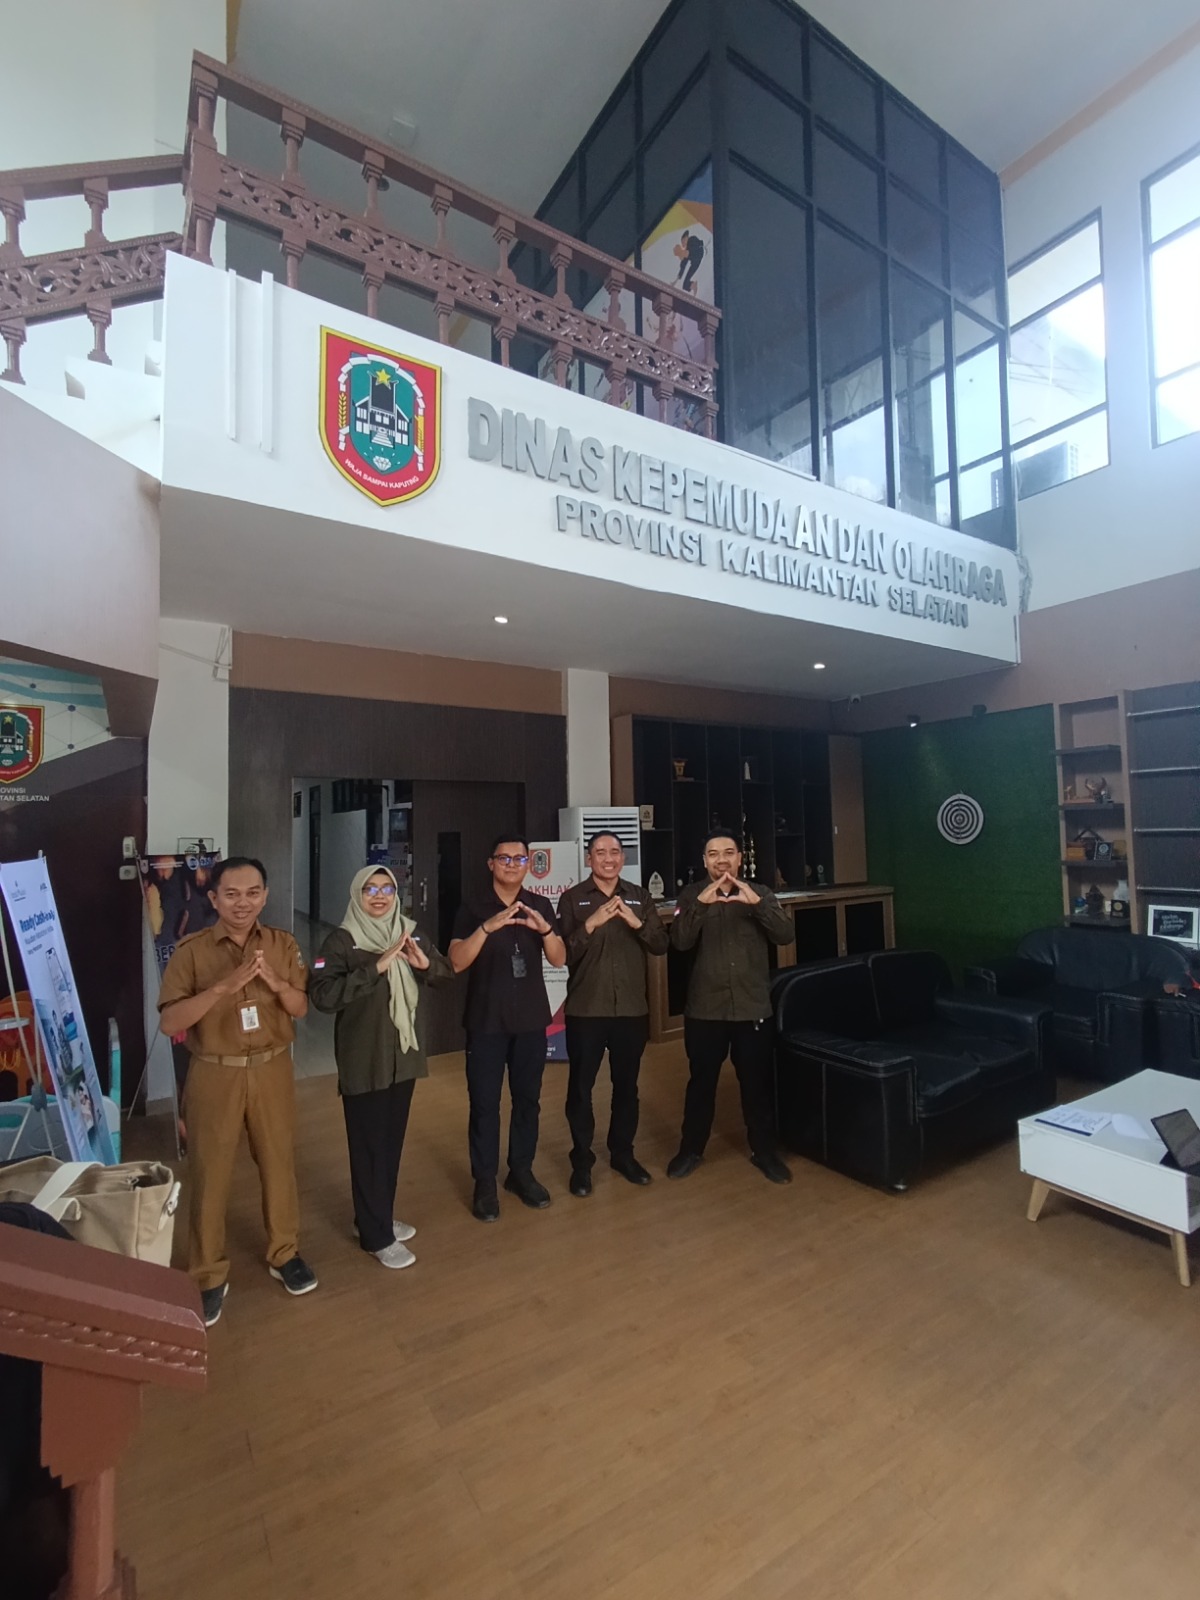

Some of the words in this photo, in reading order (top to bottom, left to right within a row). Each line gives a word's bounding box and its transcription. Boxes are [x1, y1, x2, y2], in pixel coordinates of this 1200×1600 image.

[345, 459, 362, 477] WAJA
[362, 473, 388, 488] SAMPAI
[389, 475, 419, 488] KAPUTING
[468, 396, 604, 493] DINAS
[613, 444, 833, 559] KEPEMUDAAN
[837, 517, 888, 575] DAN
[894, 538, 1007, 607] OLAHRAGA
[556, 494, 706, 566] PROVINSI
[720, 538, 880, 607] KALIMANTAN
[888, 584, 969, 628] SELATAN
